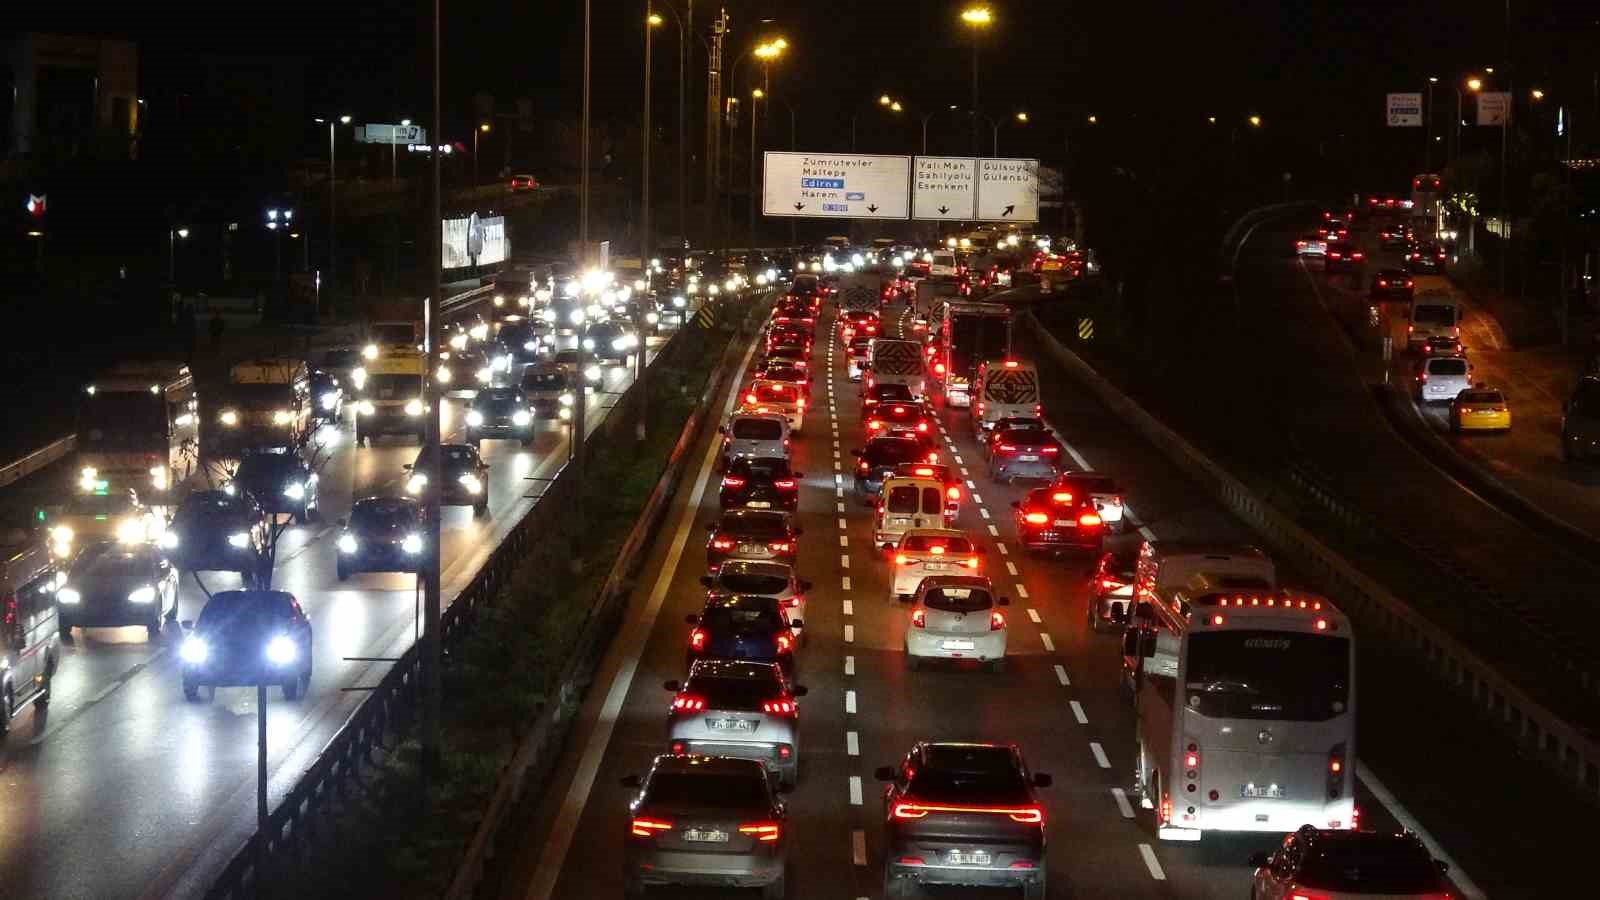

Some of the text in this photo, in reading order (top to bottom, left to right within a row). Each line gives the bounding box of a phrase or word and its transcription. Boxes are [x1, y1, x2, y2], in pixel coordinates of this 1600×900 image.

[802, 168, 847, 177] Maltepe
[802, 179, 839, 188] Edirne
[918, 182, 969, 191] Esenkent
[801, 190, 838, 198] Harem
